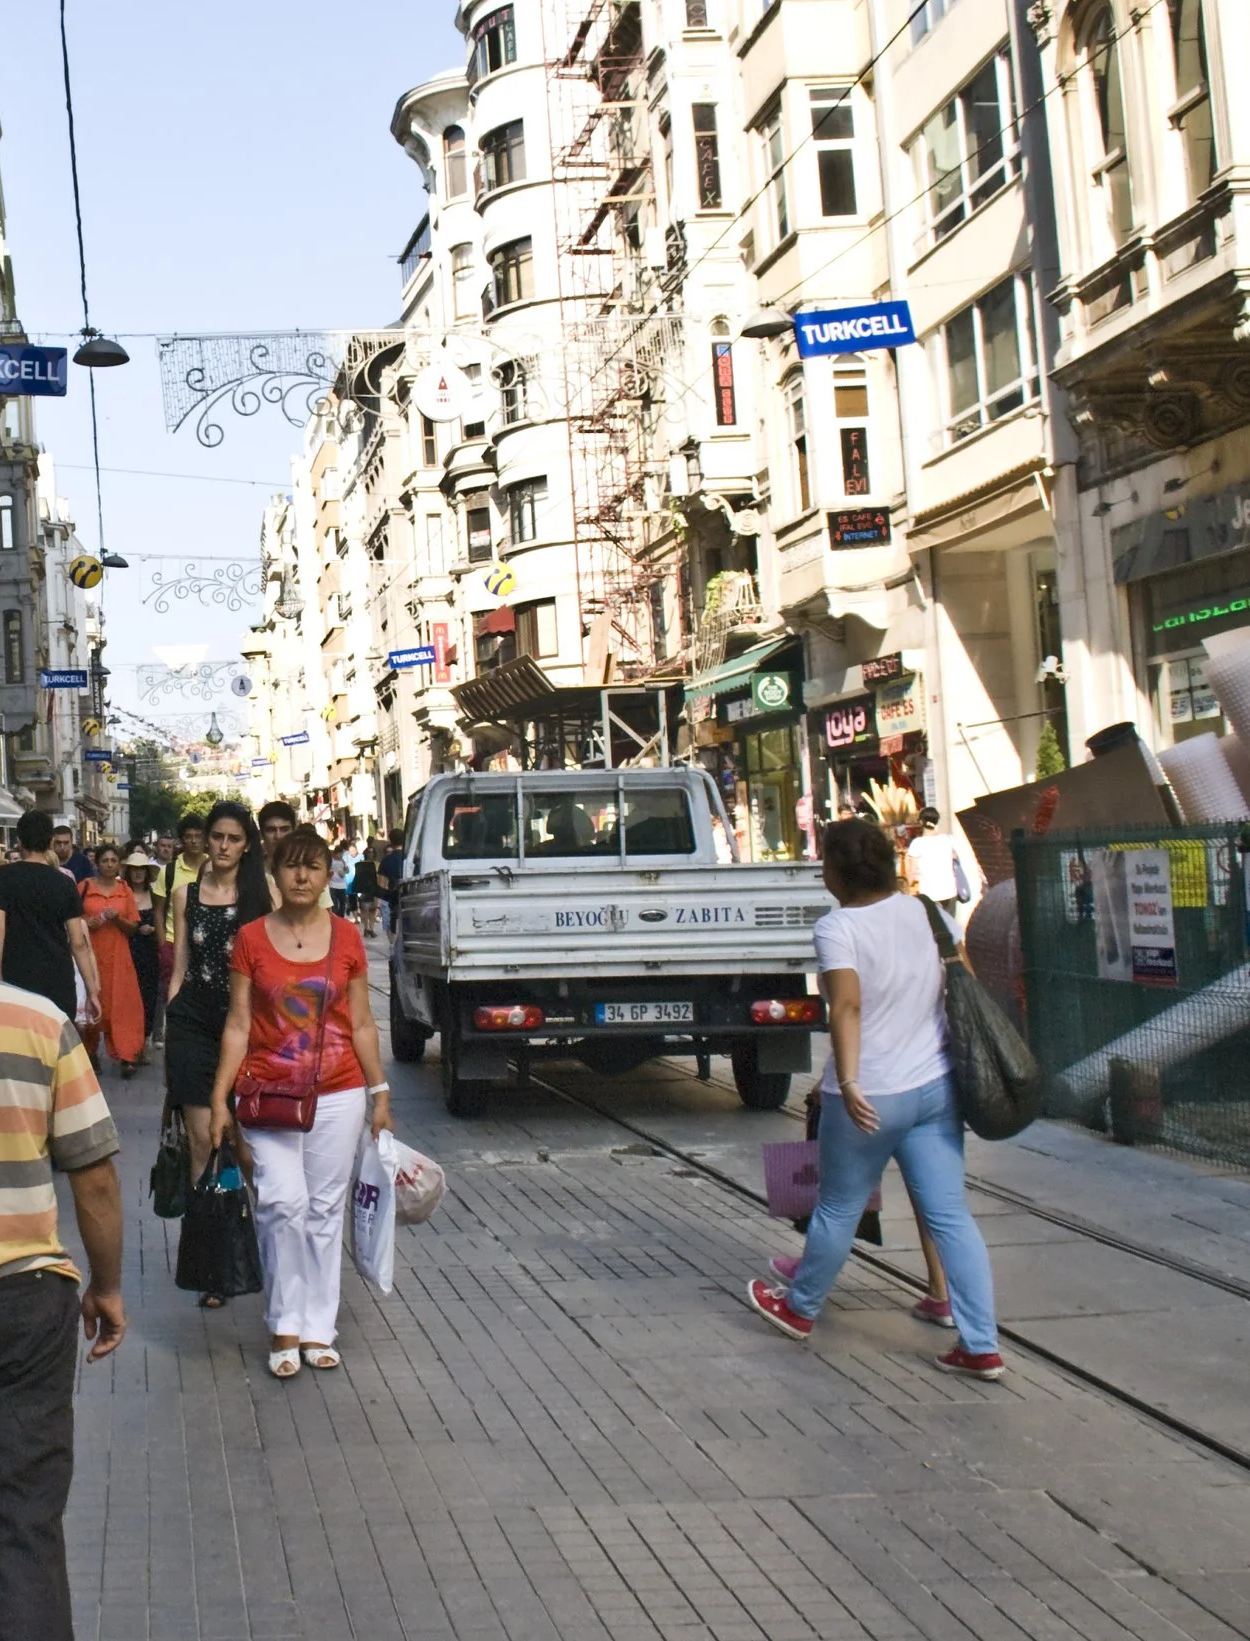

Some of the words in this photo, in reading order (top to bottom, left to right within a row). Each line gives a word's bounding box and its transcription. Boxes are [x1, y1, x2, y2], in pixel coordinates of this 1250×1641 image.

[801, 314, 908, 344] TURKCELL
[391, 650, 435, 664] TURKCELL
[676, 907, 746, 924] ZABITA
[607, 1005, 625, 1021] 34
[630, 1005, 648, 1021] GP
[654, 1004, 691, 1020] 3492
